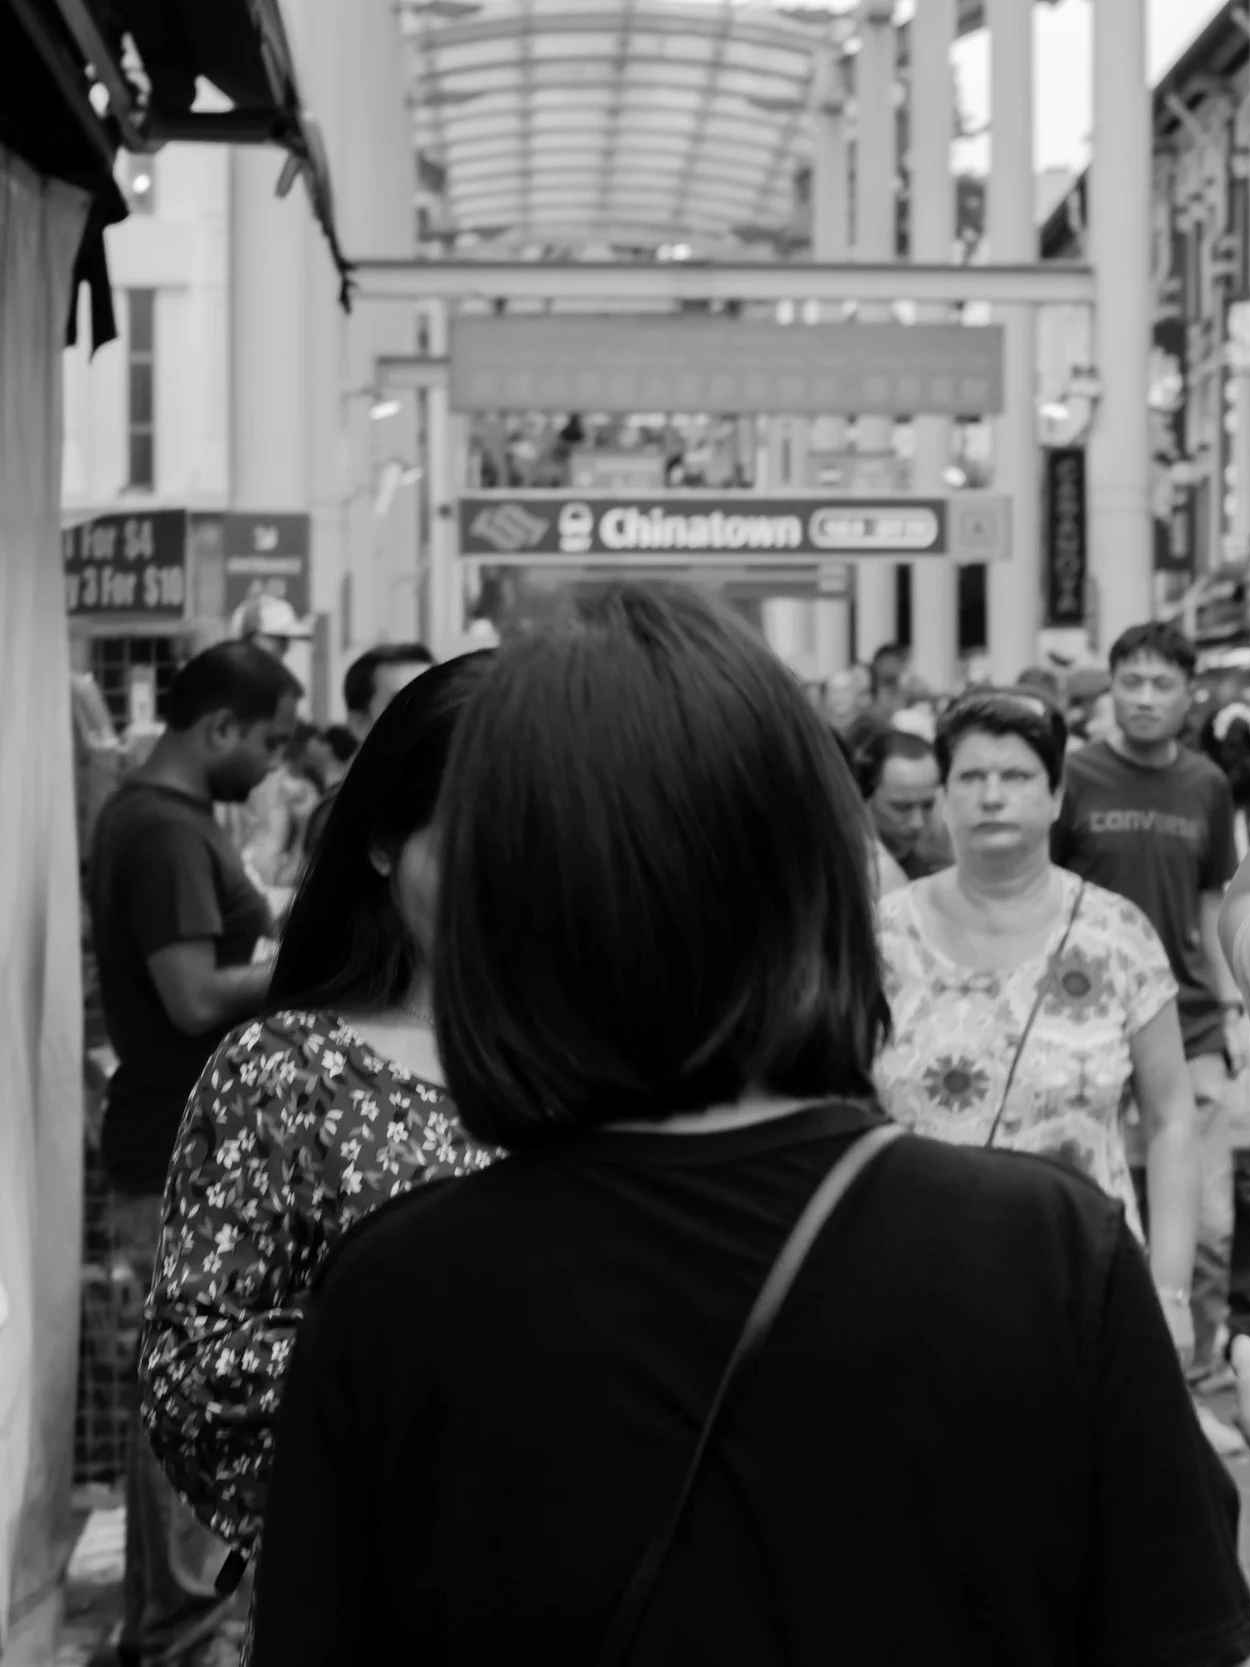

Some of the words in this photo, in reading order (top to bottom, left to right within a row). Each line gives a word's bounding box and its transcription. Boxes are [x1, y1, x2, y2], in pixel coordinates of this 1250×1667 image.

[81, 521, 117, 560] For
[124, 518, 154, 562] $4
[599, 506, 803, 550] Chinatown
[83, 565, 98, 606] 3
[101, 565, 137, 607] For
[143, 564, 184, 608] $10
